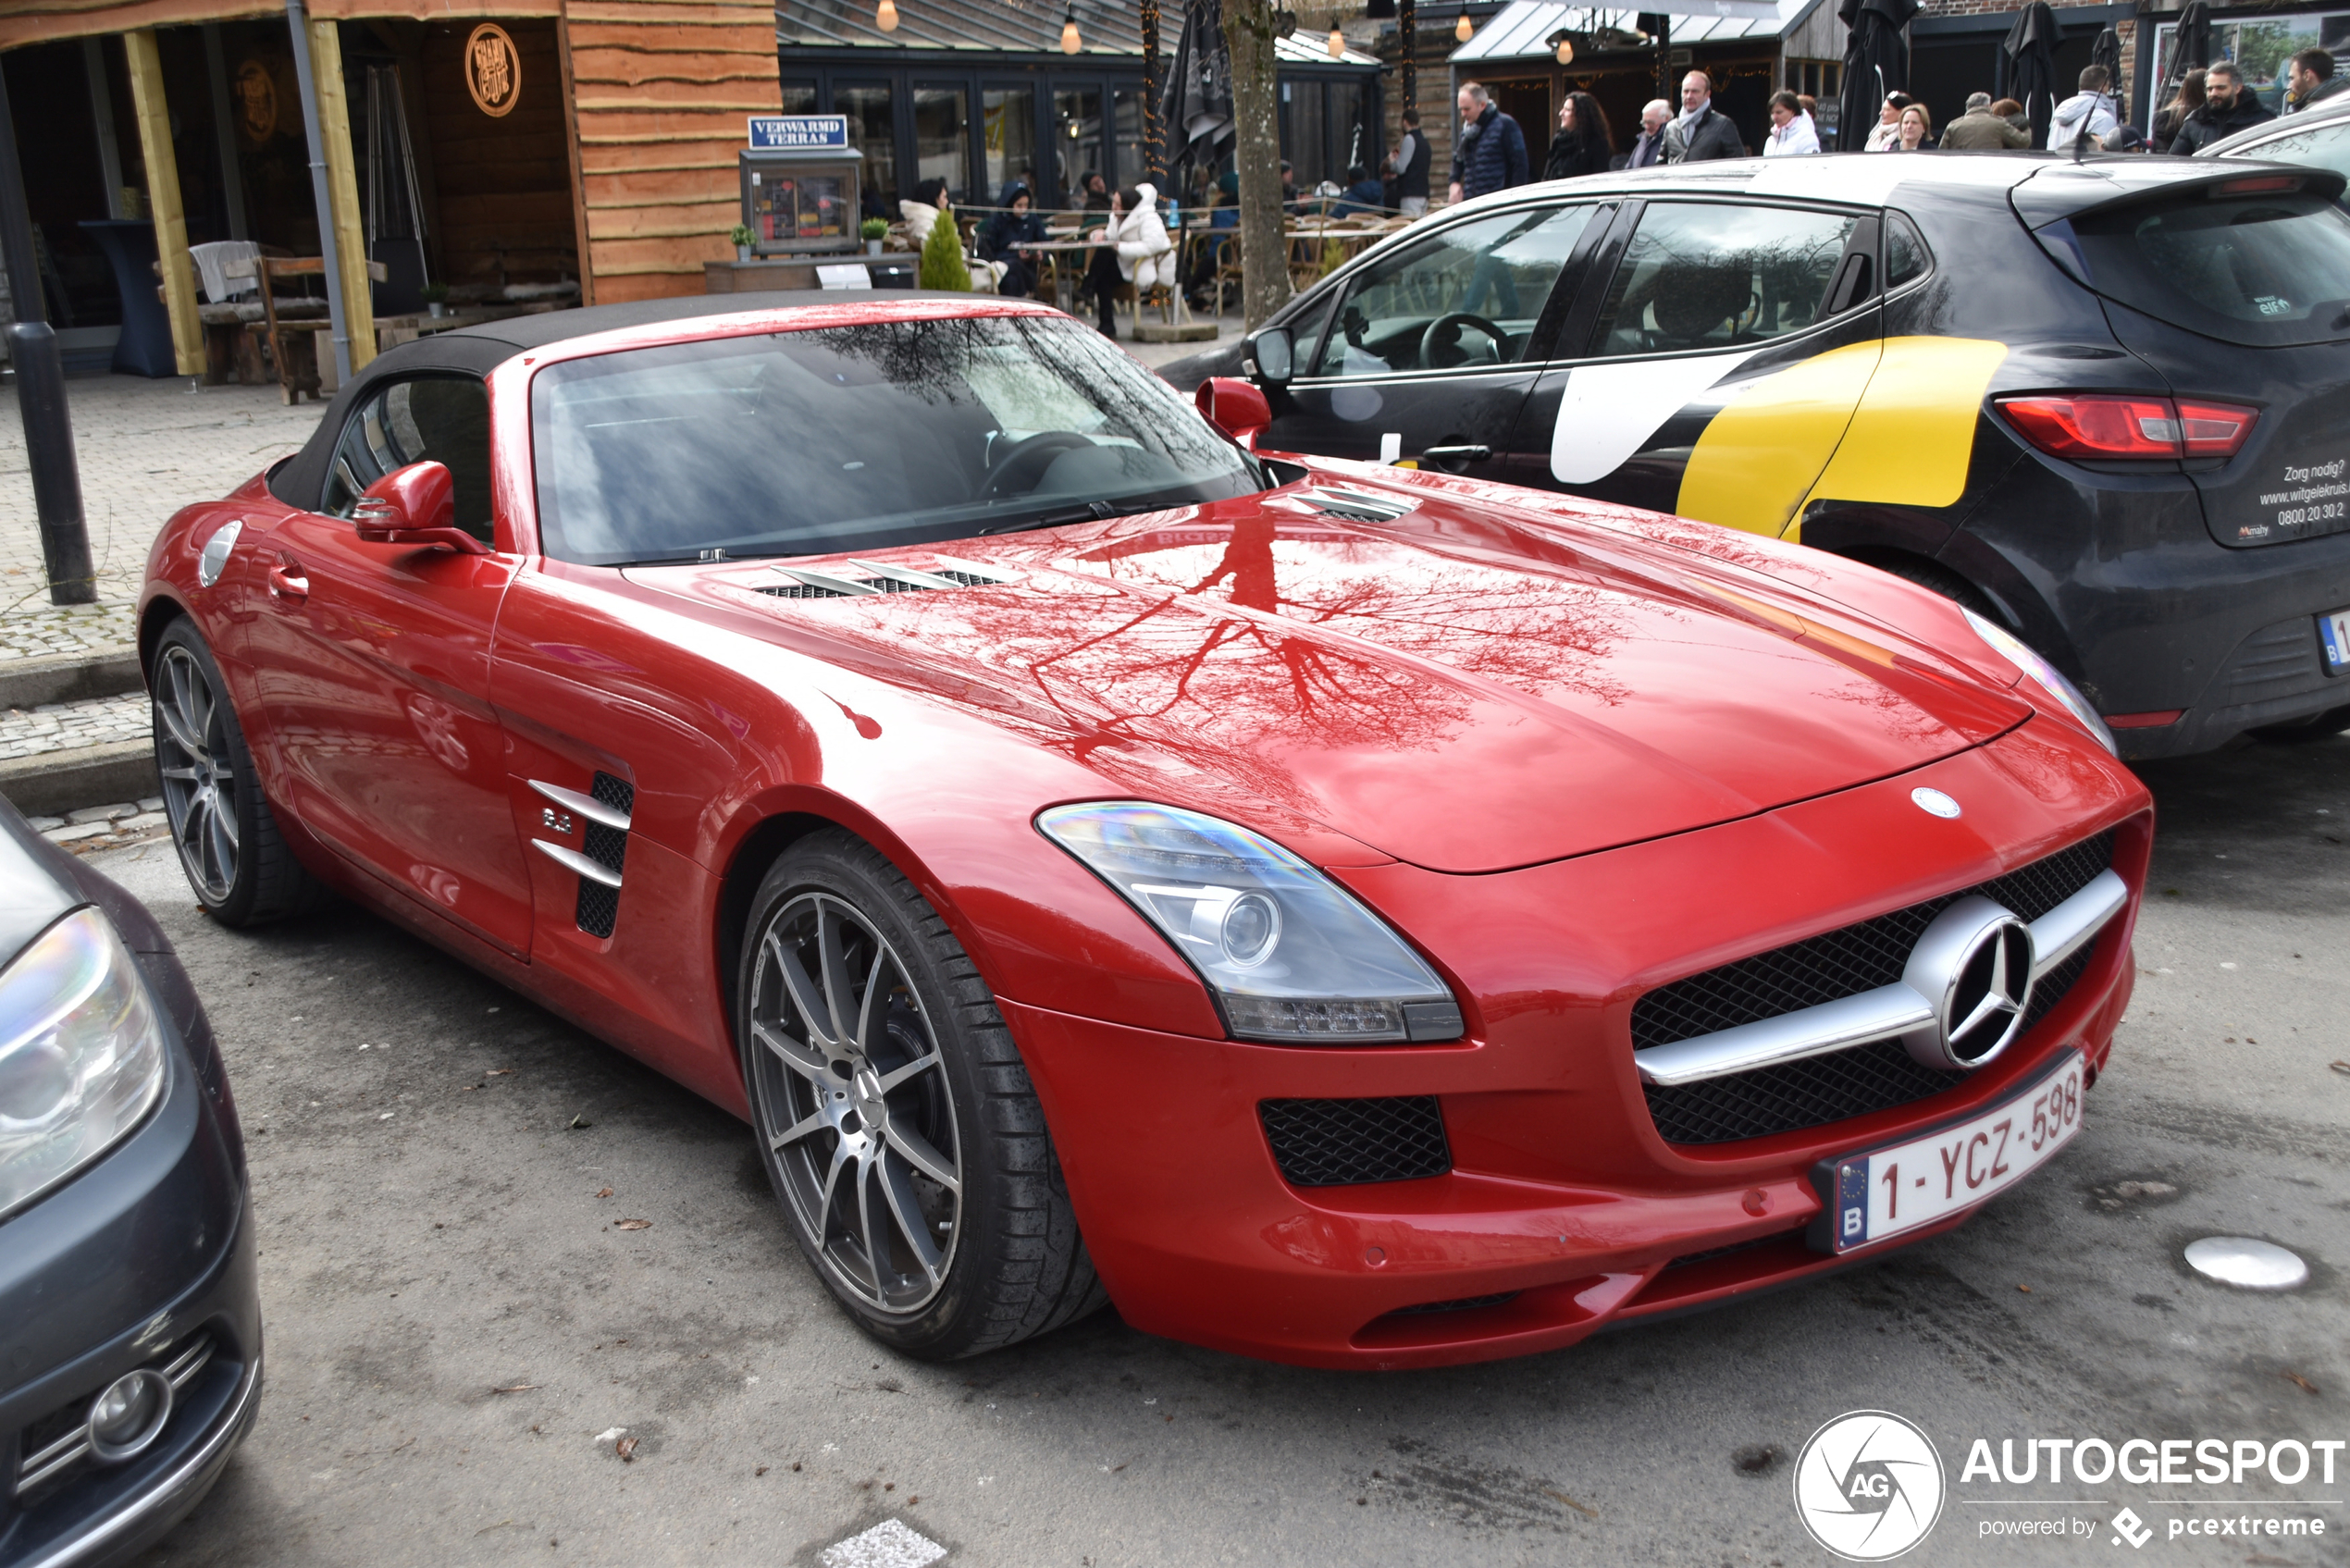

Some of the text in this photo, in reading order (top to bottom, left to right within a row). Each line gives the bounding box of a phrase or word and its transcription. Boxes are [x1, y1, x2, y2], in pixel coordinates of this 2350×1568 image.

[755, 120, 840, 133] VERWARMD
[767, 132, 828, 145] TERRAS
[2259, 302, 2278, 314] elf
[2283, 459, 2344, 482] Zorg nodig?
[2278, 508, 2305, 525] 0800
[2307, 506, 2320, 521] 20
[2322, 503, 2334, 519] 30
[2326, 645, 2337, 661] B
[543, 808, 572, 833] 6.3
[1881, 1070, 2078, 1220] 1-YCZ-598
[1843, 1206, 1862, 1237] B
